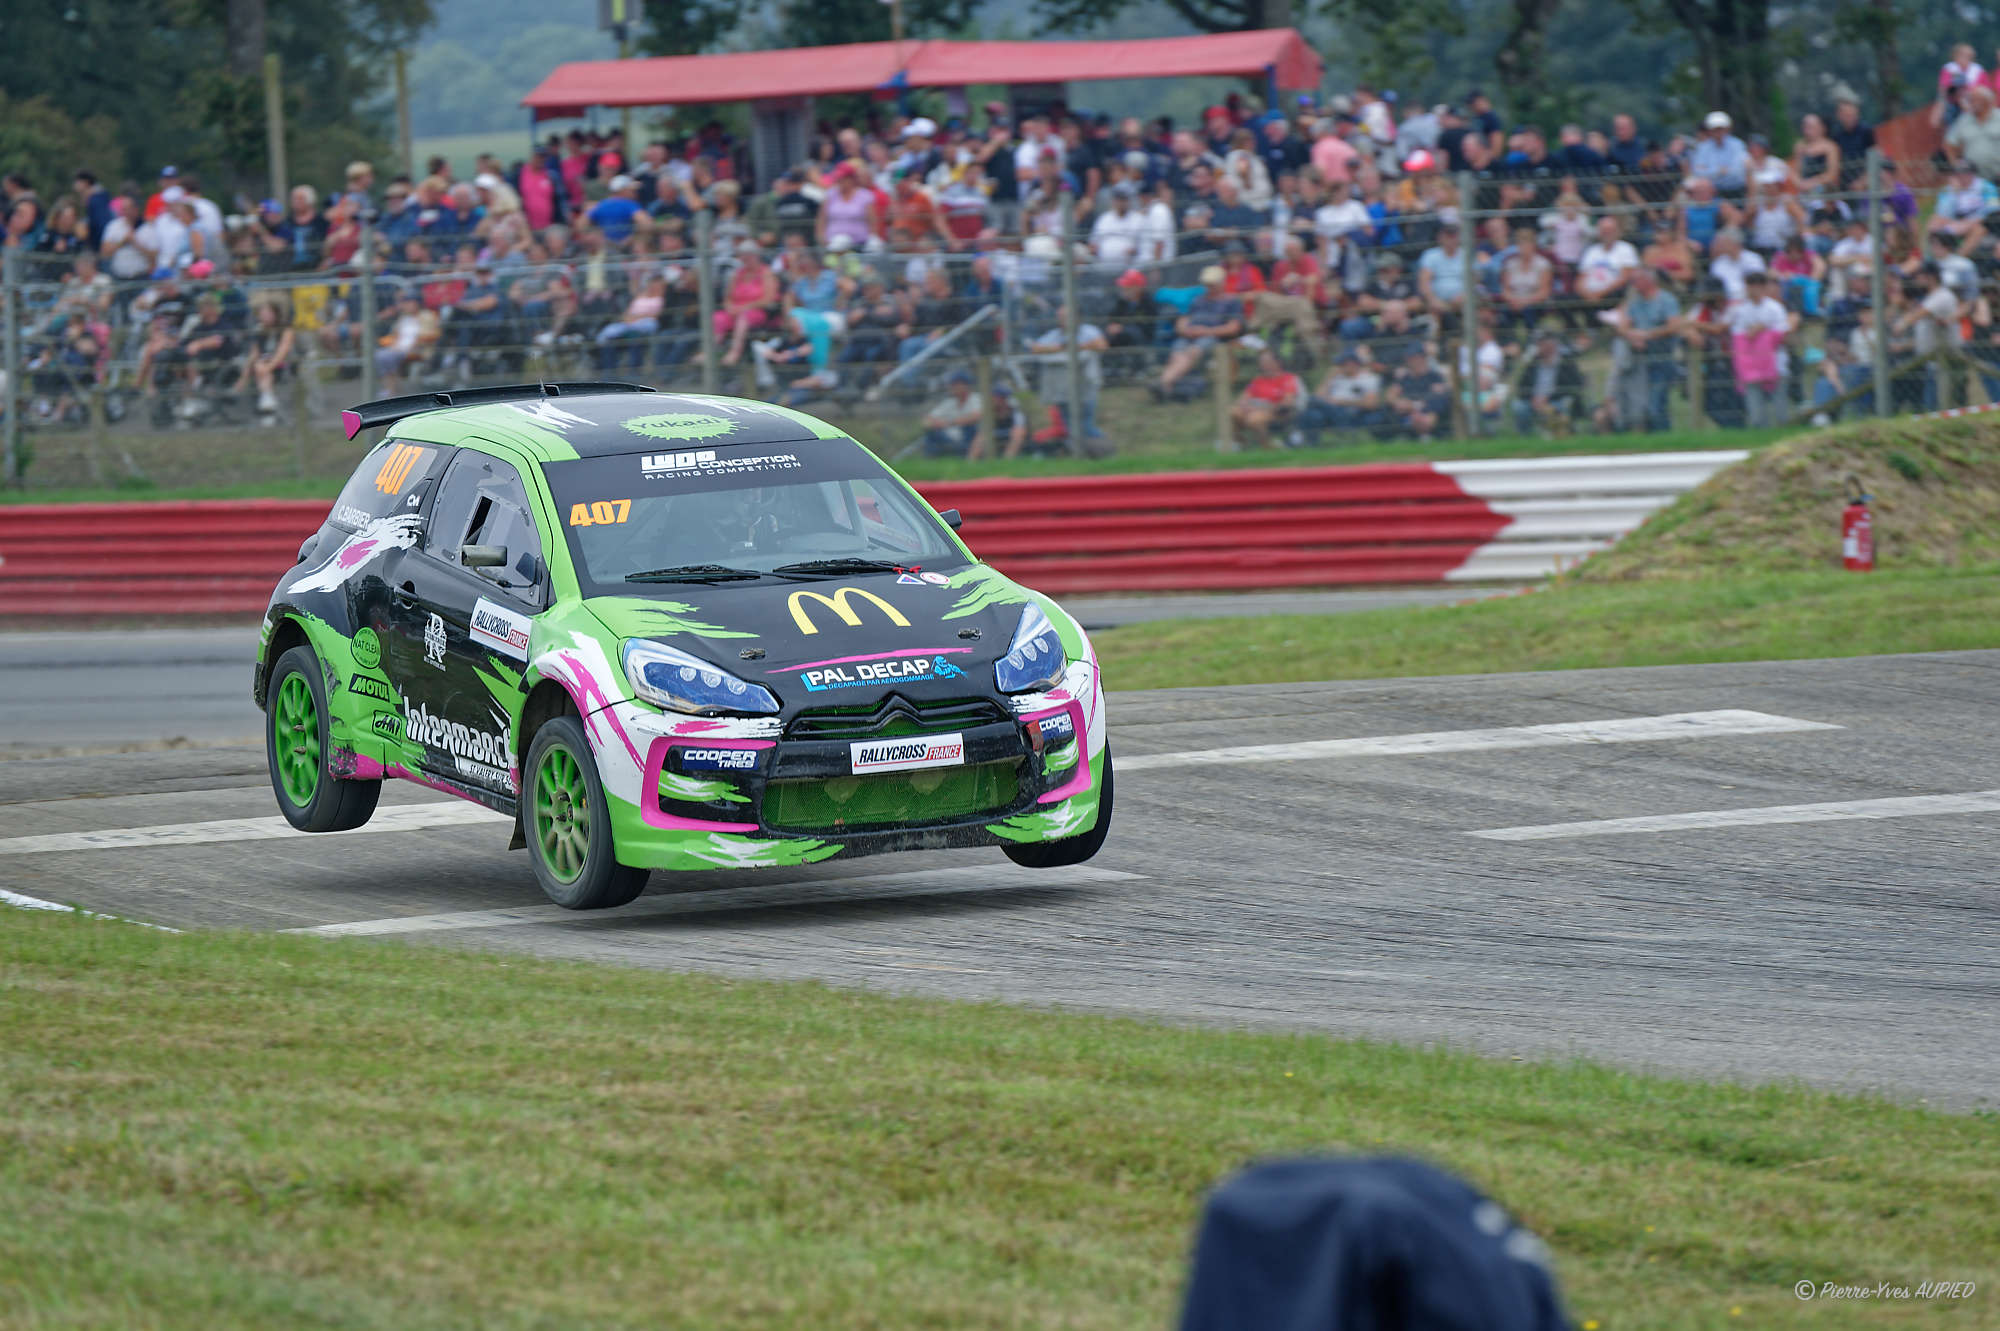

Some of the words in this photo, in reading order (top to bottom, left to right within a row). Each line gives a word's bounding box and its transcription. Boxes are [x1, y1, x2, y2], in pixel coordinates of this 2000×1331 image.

[631, 417, 720, 429] Yukadi
[375, 443, 424, 495] 407
[641, 450, 716, 470] LUDO
[698, 454, 797, 469] CONCEPTION
[644, 470, 701, 480] RACING
[706, 462, 801, 475] COMPETITION
[569, 498, 632, 527] 407
[474, 609, 512, 638] RALLYCROSS
[509, 630, 528, 649] FRANCE
[352, 639, 365, 650] NAT
[806, 667, 855, 686] PAL
[856, 659, 930, 680] DECAP
[351, 676, 389, 700] MOTUL
[866, 679, 881, 687] PAR
[1039, 713, 1072, 732] COOPER
[683, 750, 757, 761] COOPER
[859, 743, 927, 764] RALLYCROSS
[928, 745, 961, 760] FRANCE
[718, 760, 755, 768] TIRES
